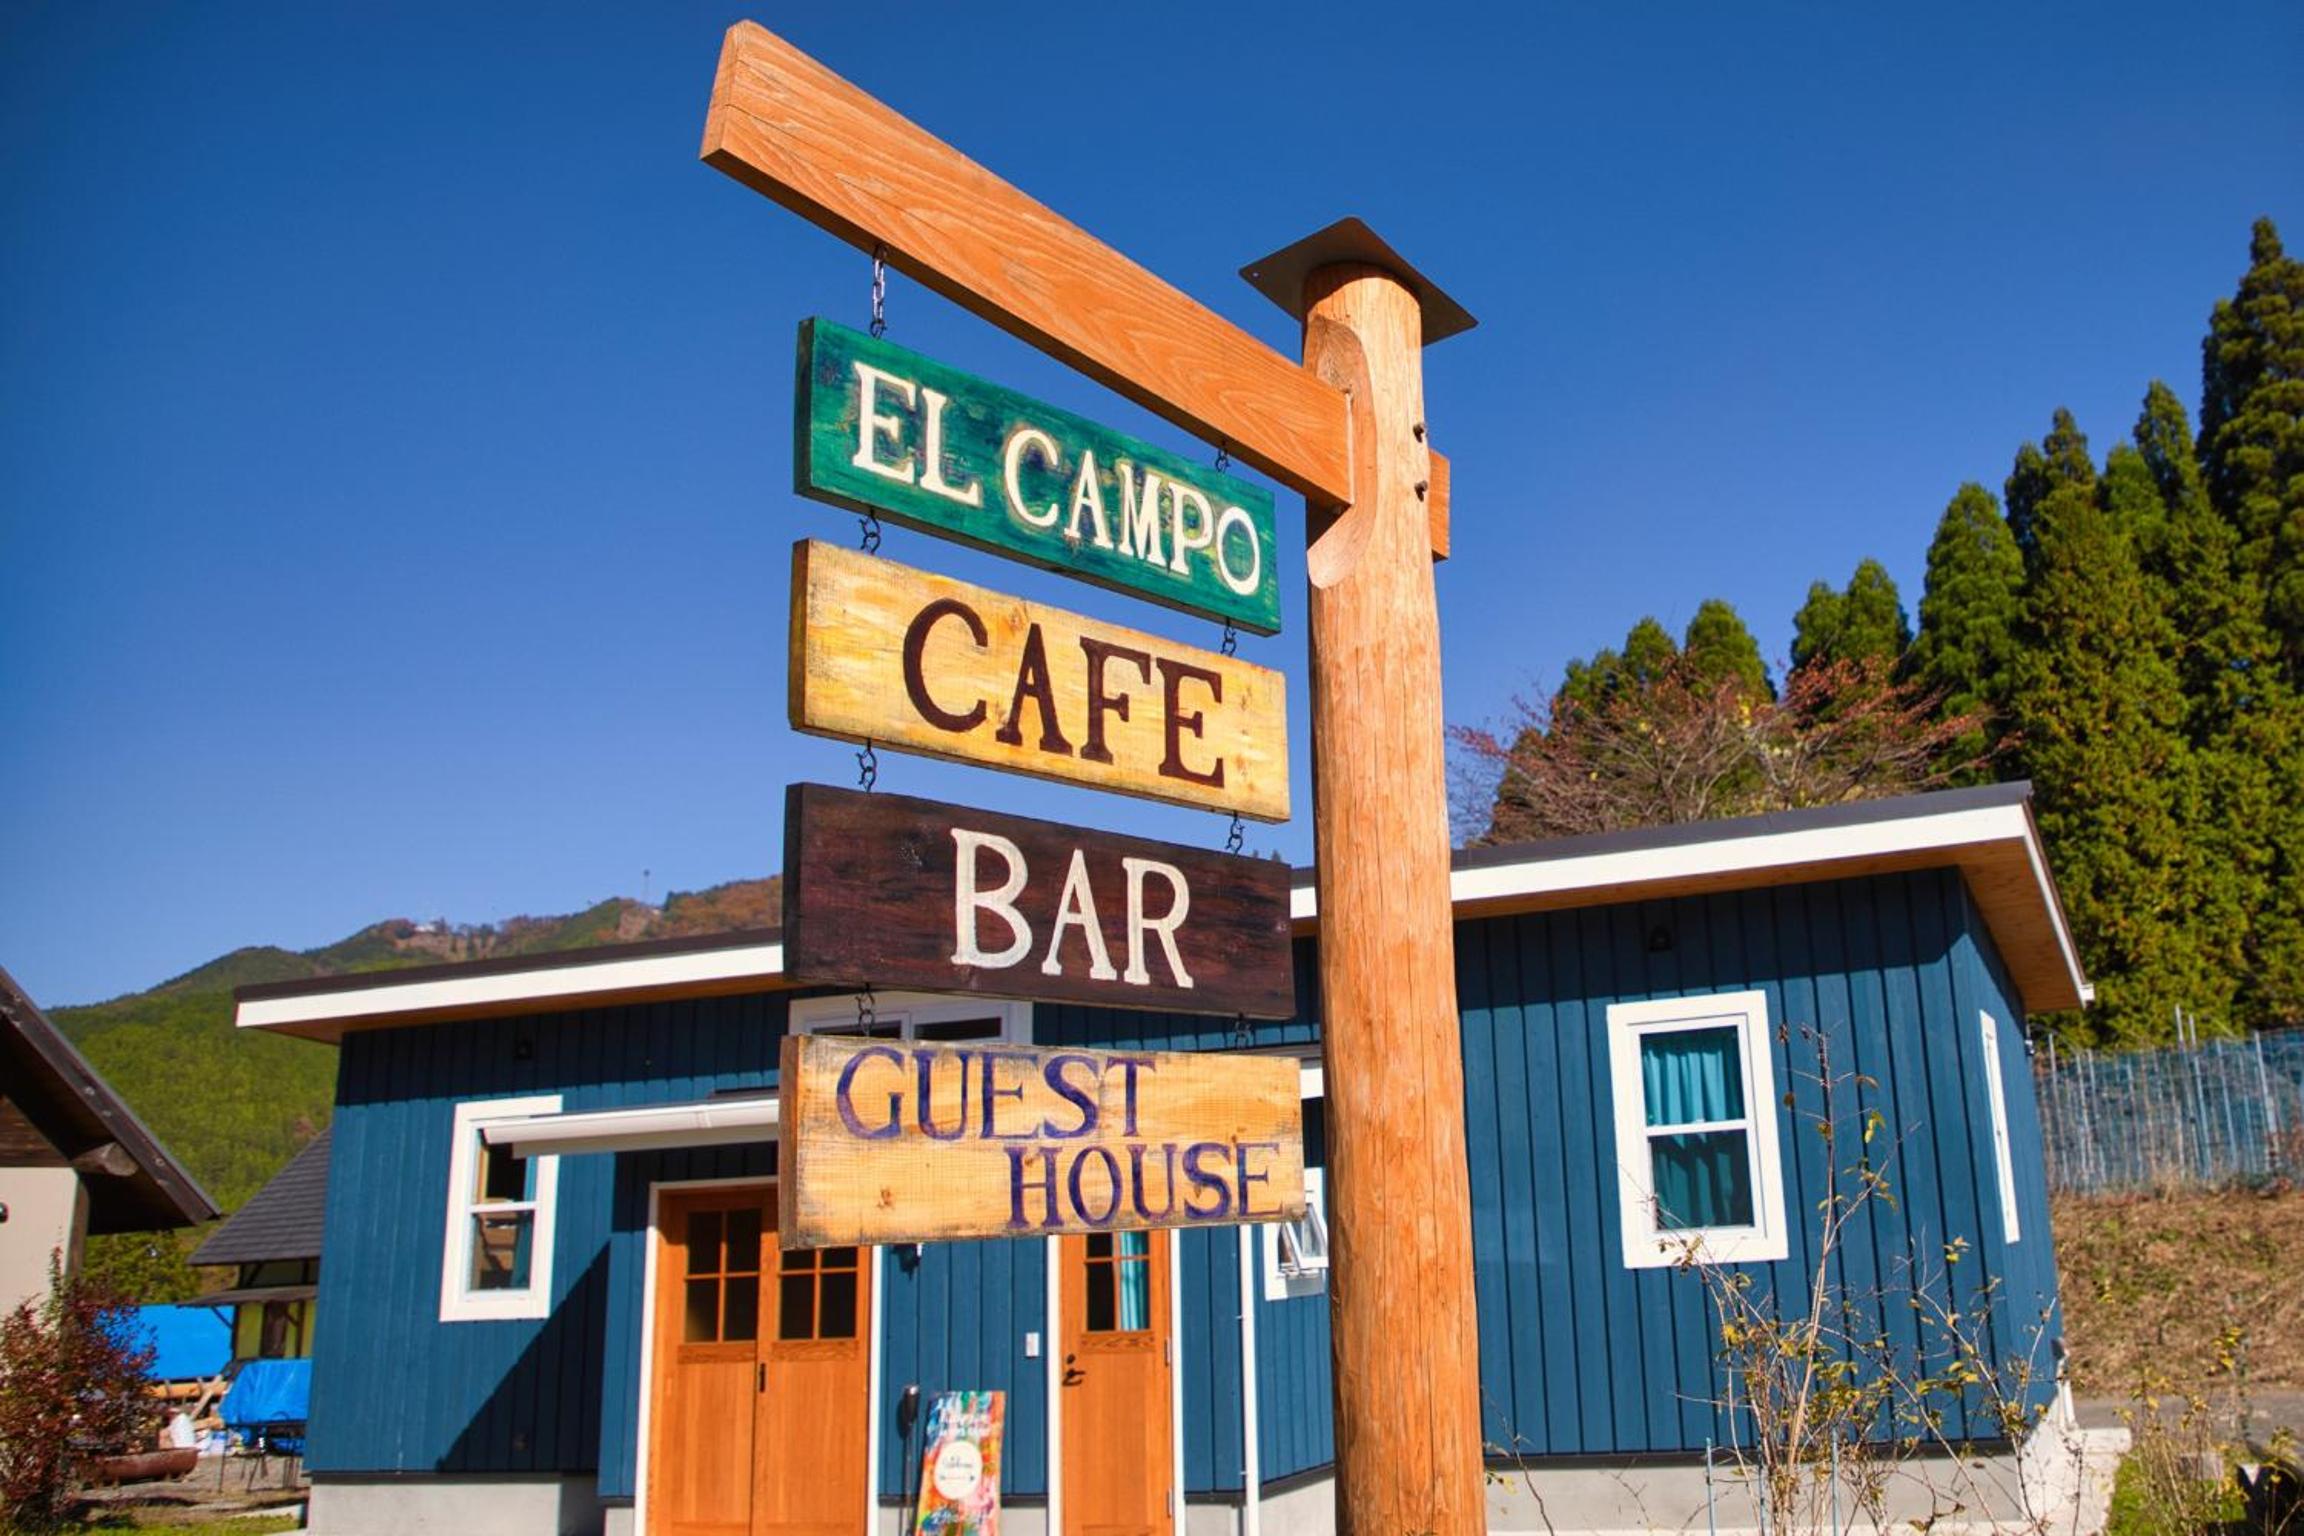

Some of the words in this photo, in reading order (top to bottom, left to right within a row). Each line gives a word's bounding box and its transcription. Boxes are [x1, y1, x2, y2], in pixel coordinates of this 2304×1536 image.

[853, 361, 979, 506] EL
[1004, 428, 1261, 596] CAMPO
[903, 598, 1225, 788] CAFE
[950, 828, 1194, 988] BAR
[836, 1046, 1156, 1141] GUEST
[1006, 1142, 1284, 1229] HOUSE
